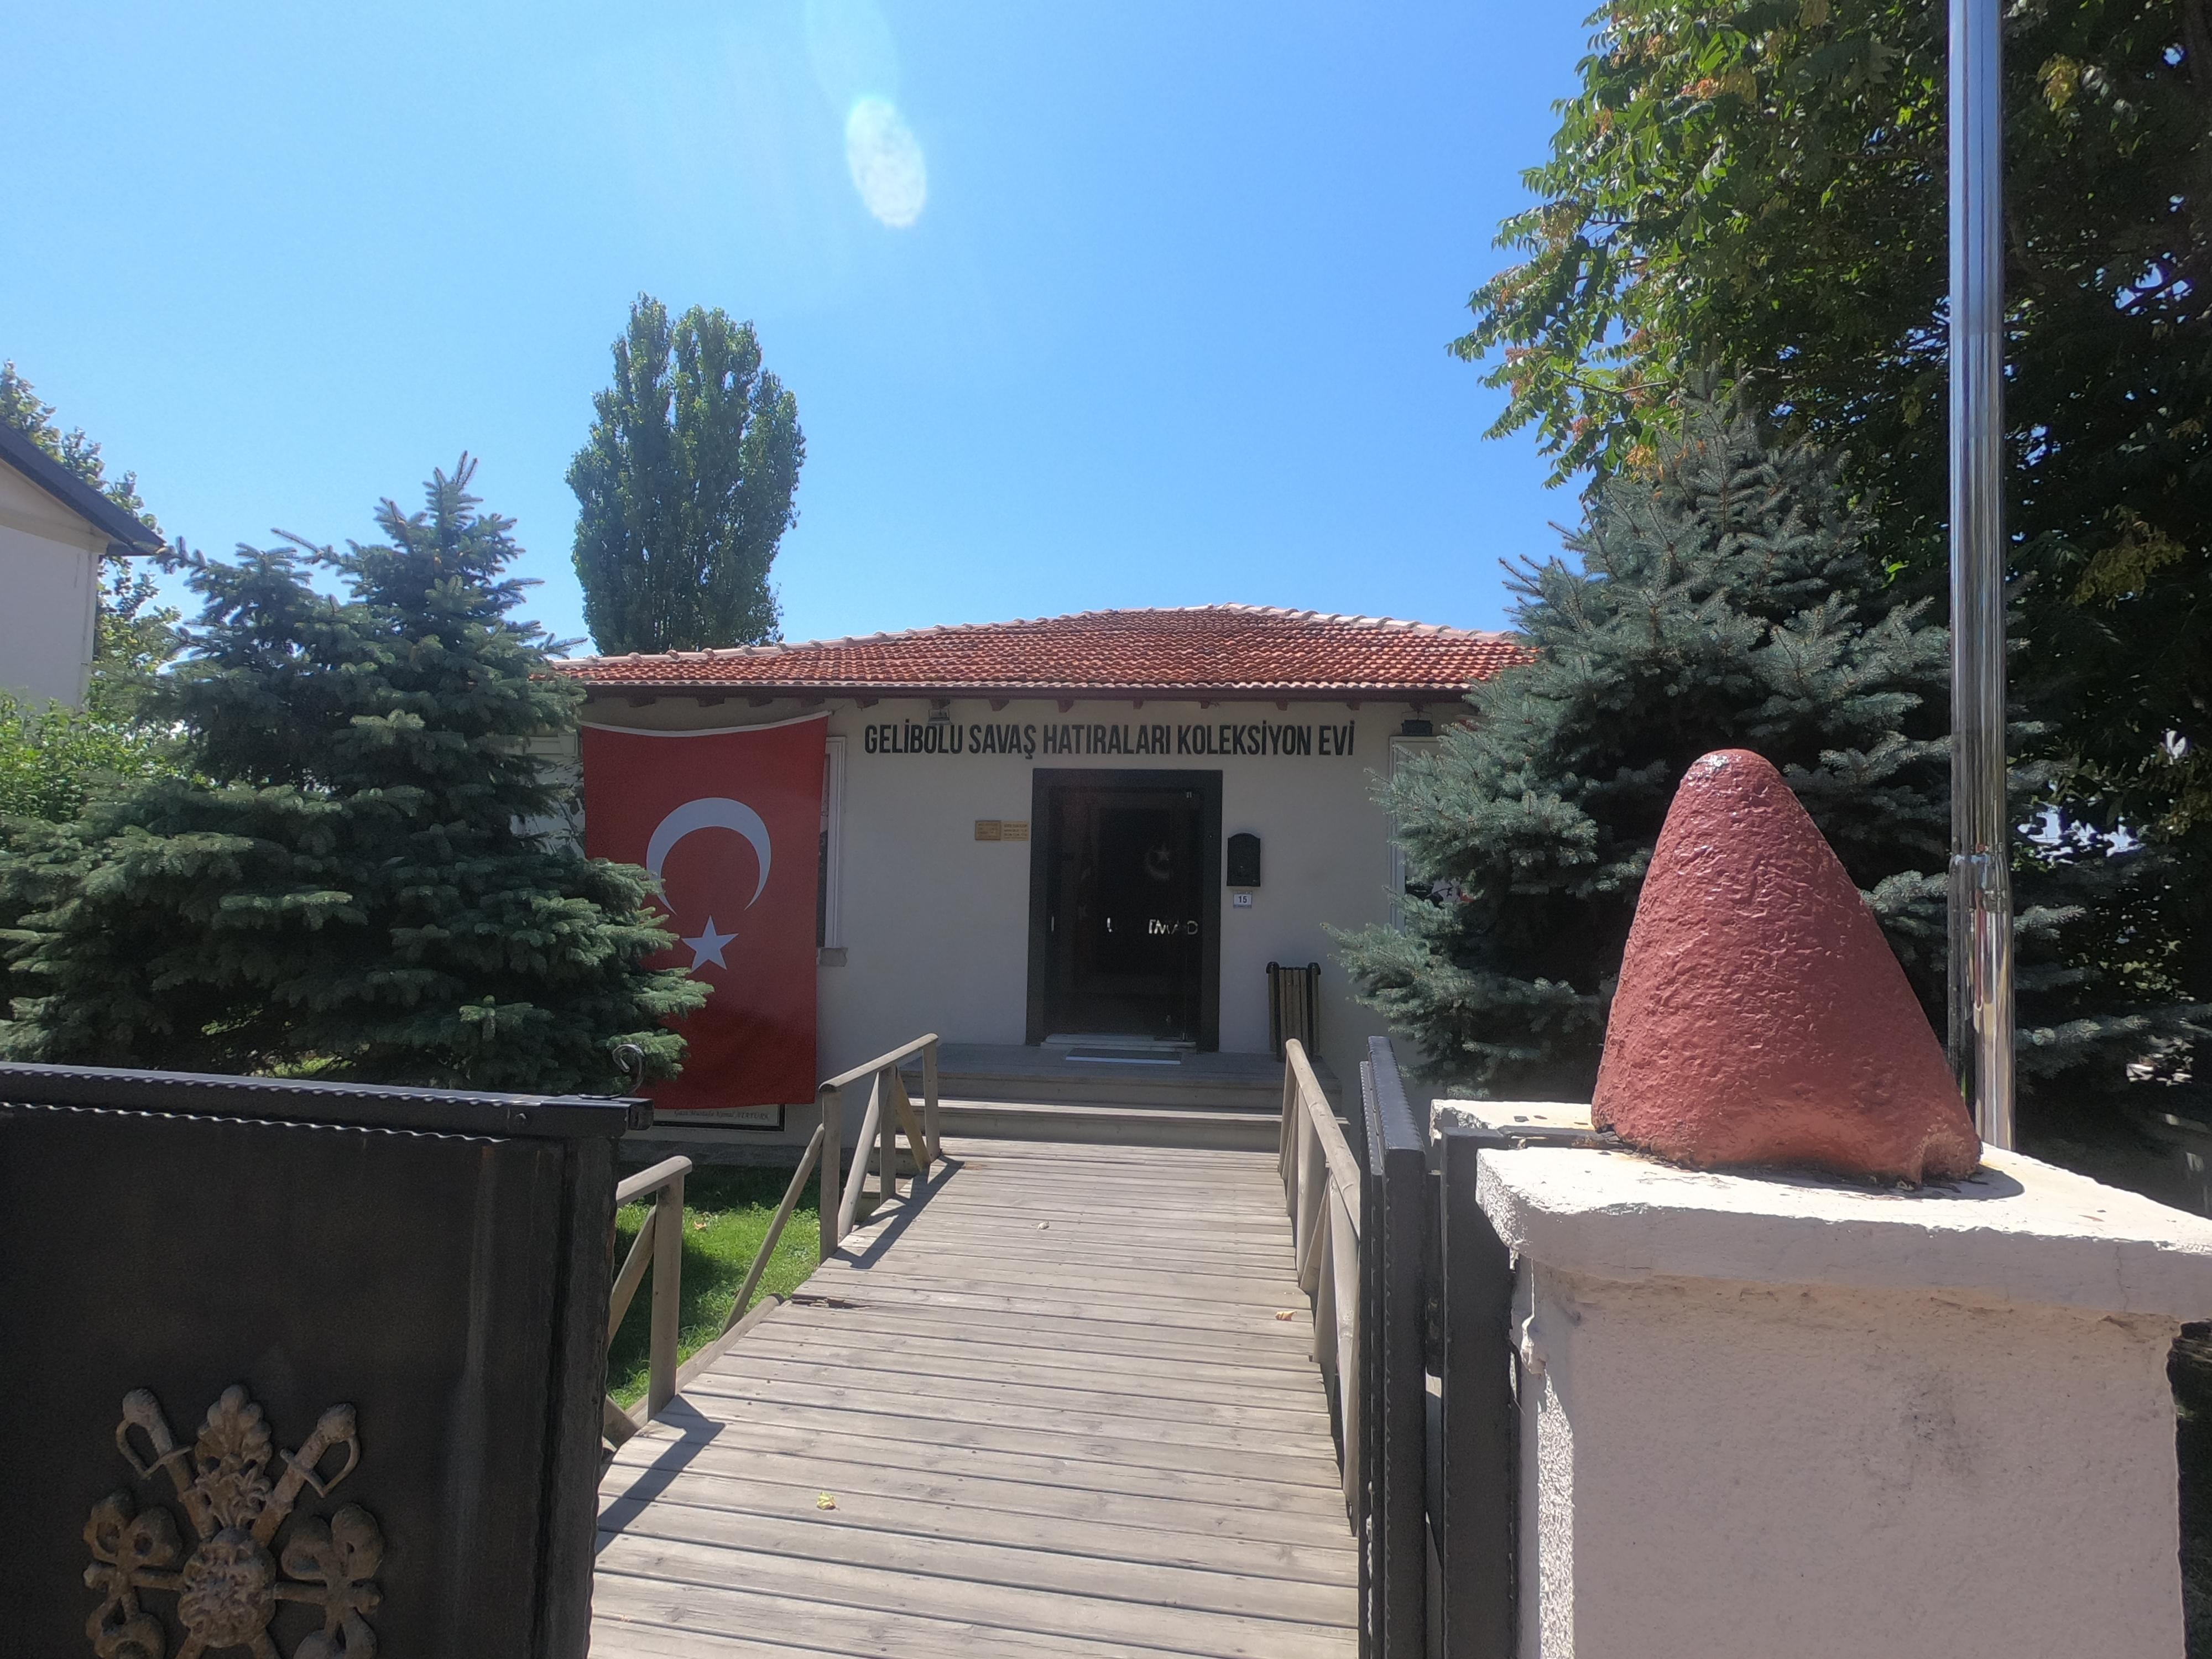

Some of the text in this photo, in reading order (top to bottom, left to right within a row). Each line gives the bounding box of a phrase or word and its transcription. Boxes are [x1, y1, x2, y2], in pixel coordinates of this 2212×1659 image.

[864, 718, 1355, 759] GELİBOLU SAVAŞ HATIRALARI KOLEKSİYON EVİ
